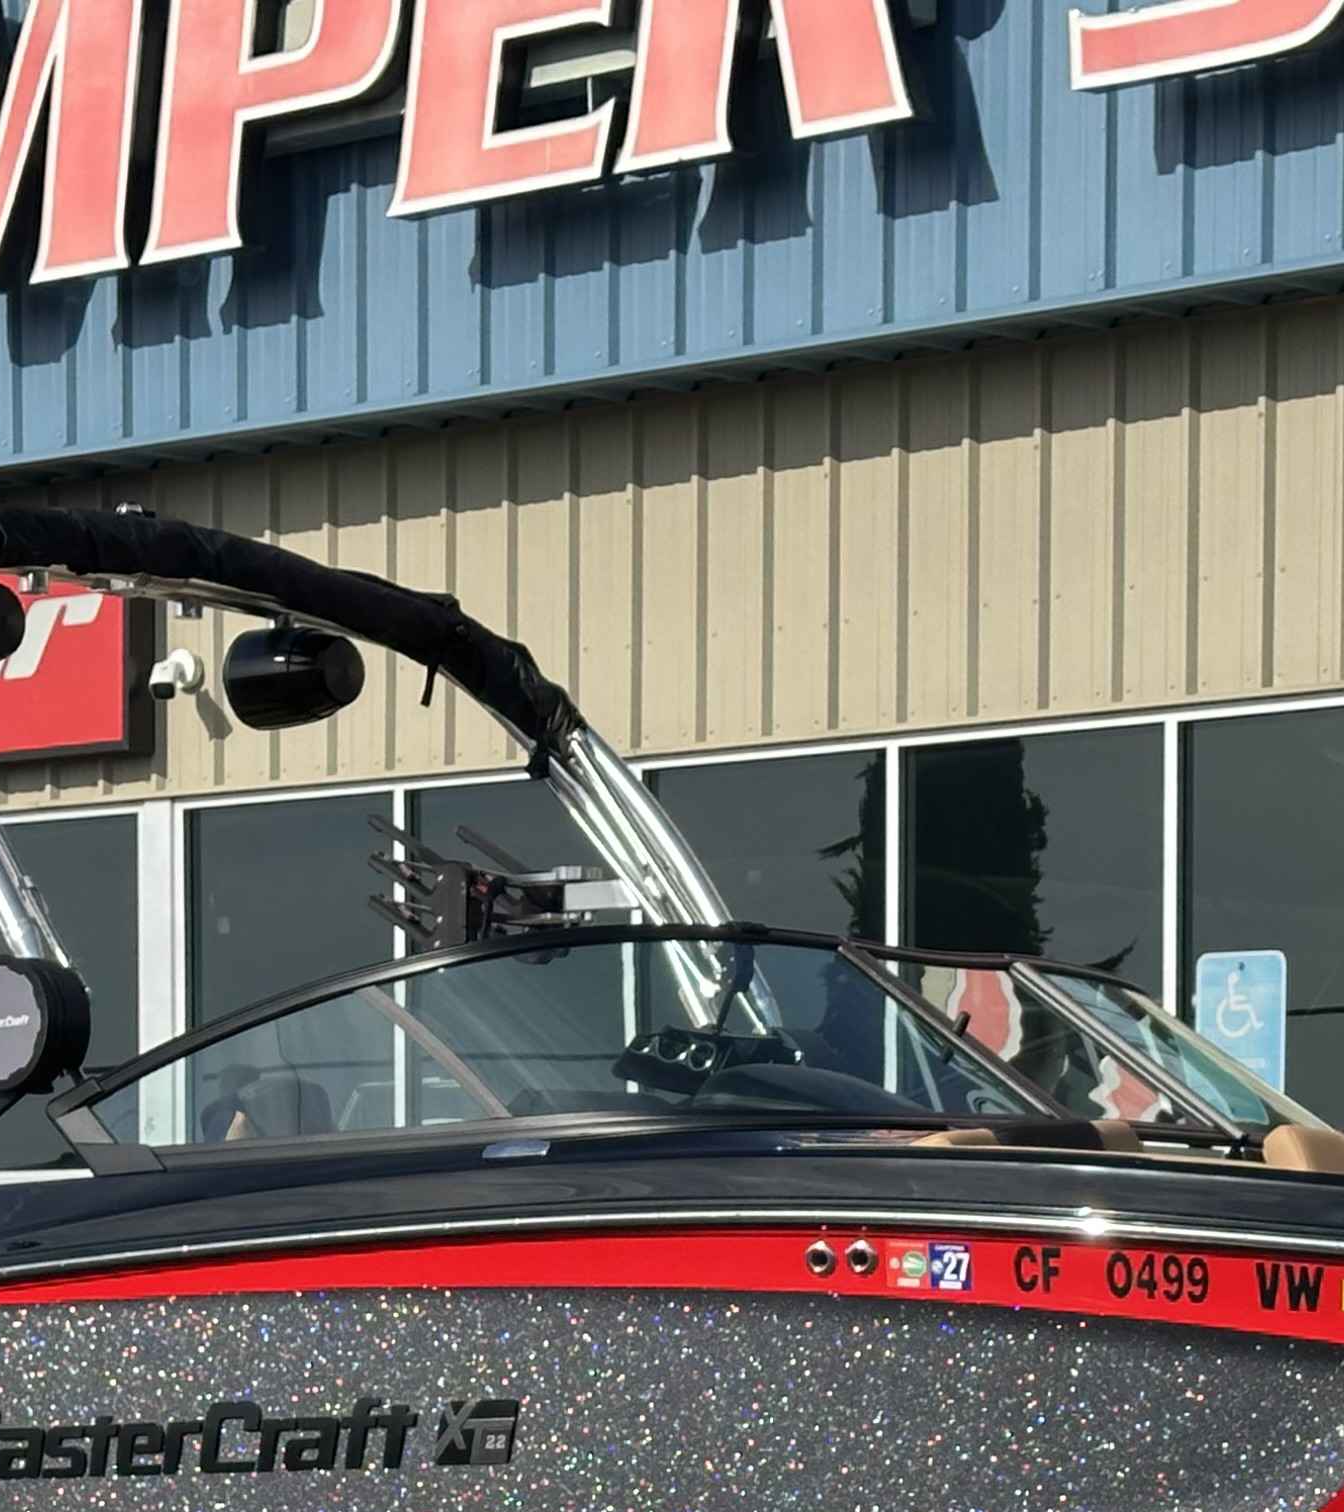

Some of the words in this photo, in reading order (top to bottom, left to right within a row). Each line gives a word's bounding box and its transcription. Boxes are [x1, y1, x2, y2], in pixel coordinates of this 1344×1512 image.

[942, 1251, 971, 1282] 27
[1013, 1247, 1061, 1293] CF
[1106, 1252, 1210, 1304] 0499
[1257, 1261, 1323, 1313] VW
[484, 1434, 507, 1450] 22
